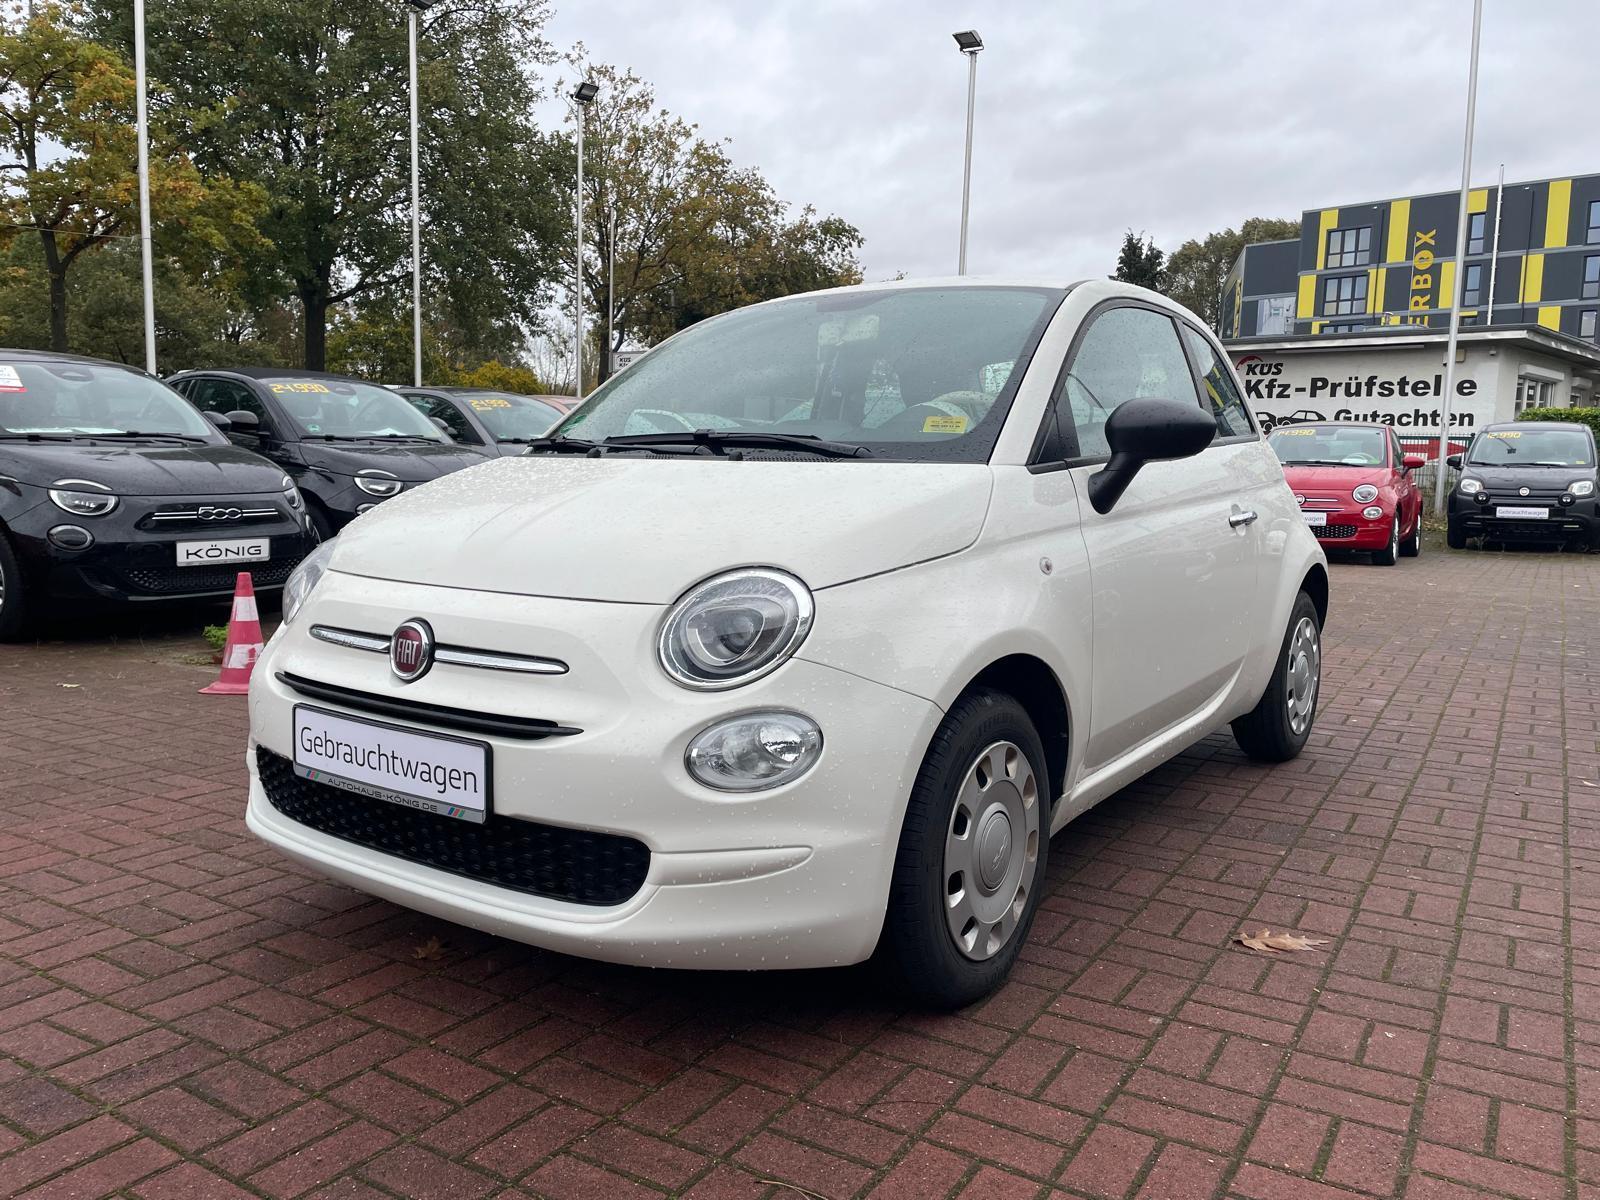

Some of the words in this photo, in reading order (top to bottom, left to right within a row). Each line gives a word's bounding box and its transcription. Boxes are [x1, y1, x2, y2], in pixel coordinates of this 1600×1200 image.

[1246, 362, 1284, 376] KÜS
[1245, 374, 1478, 399] Kfz-Prüfstele
[198, 506, 242, 520] 500
[186, 544, 262, 559] KÖNIG
[396, 638, 419, 664] FIAT
[300, 726, 478, 793] Gebrauchtwagen
